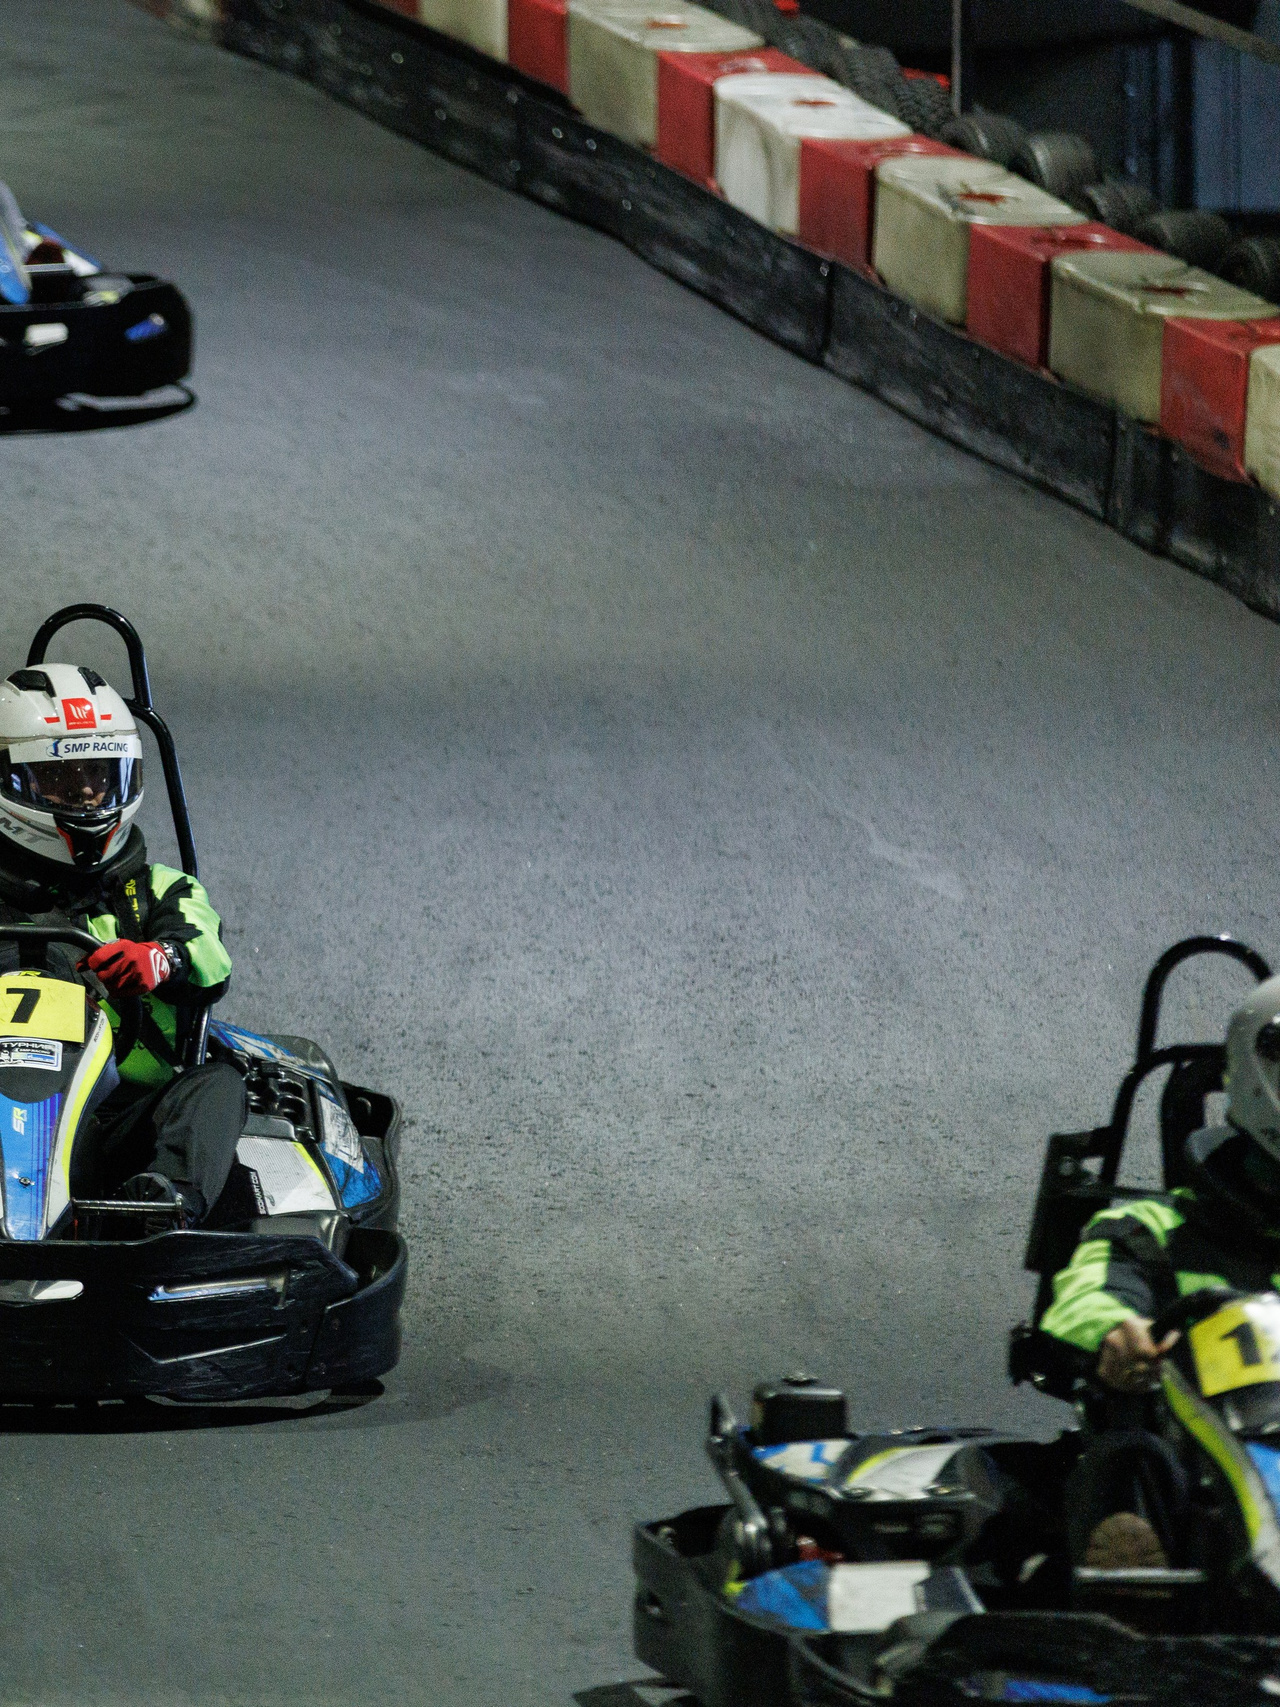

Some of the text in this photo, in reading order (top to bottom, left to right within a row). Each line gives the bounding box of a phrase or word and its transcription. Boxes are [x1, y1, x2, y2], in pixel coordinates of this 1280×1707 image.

[64, 741, 128, 754] SMP RACING
[6, 988, 41, 1024] 7
